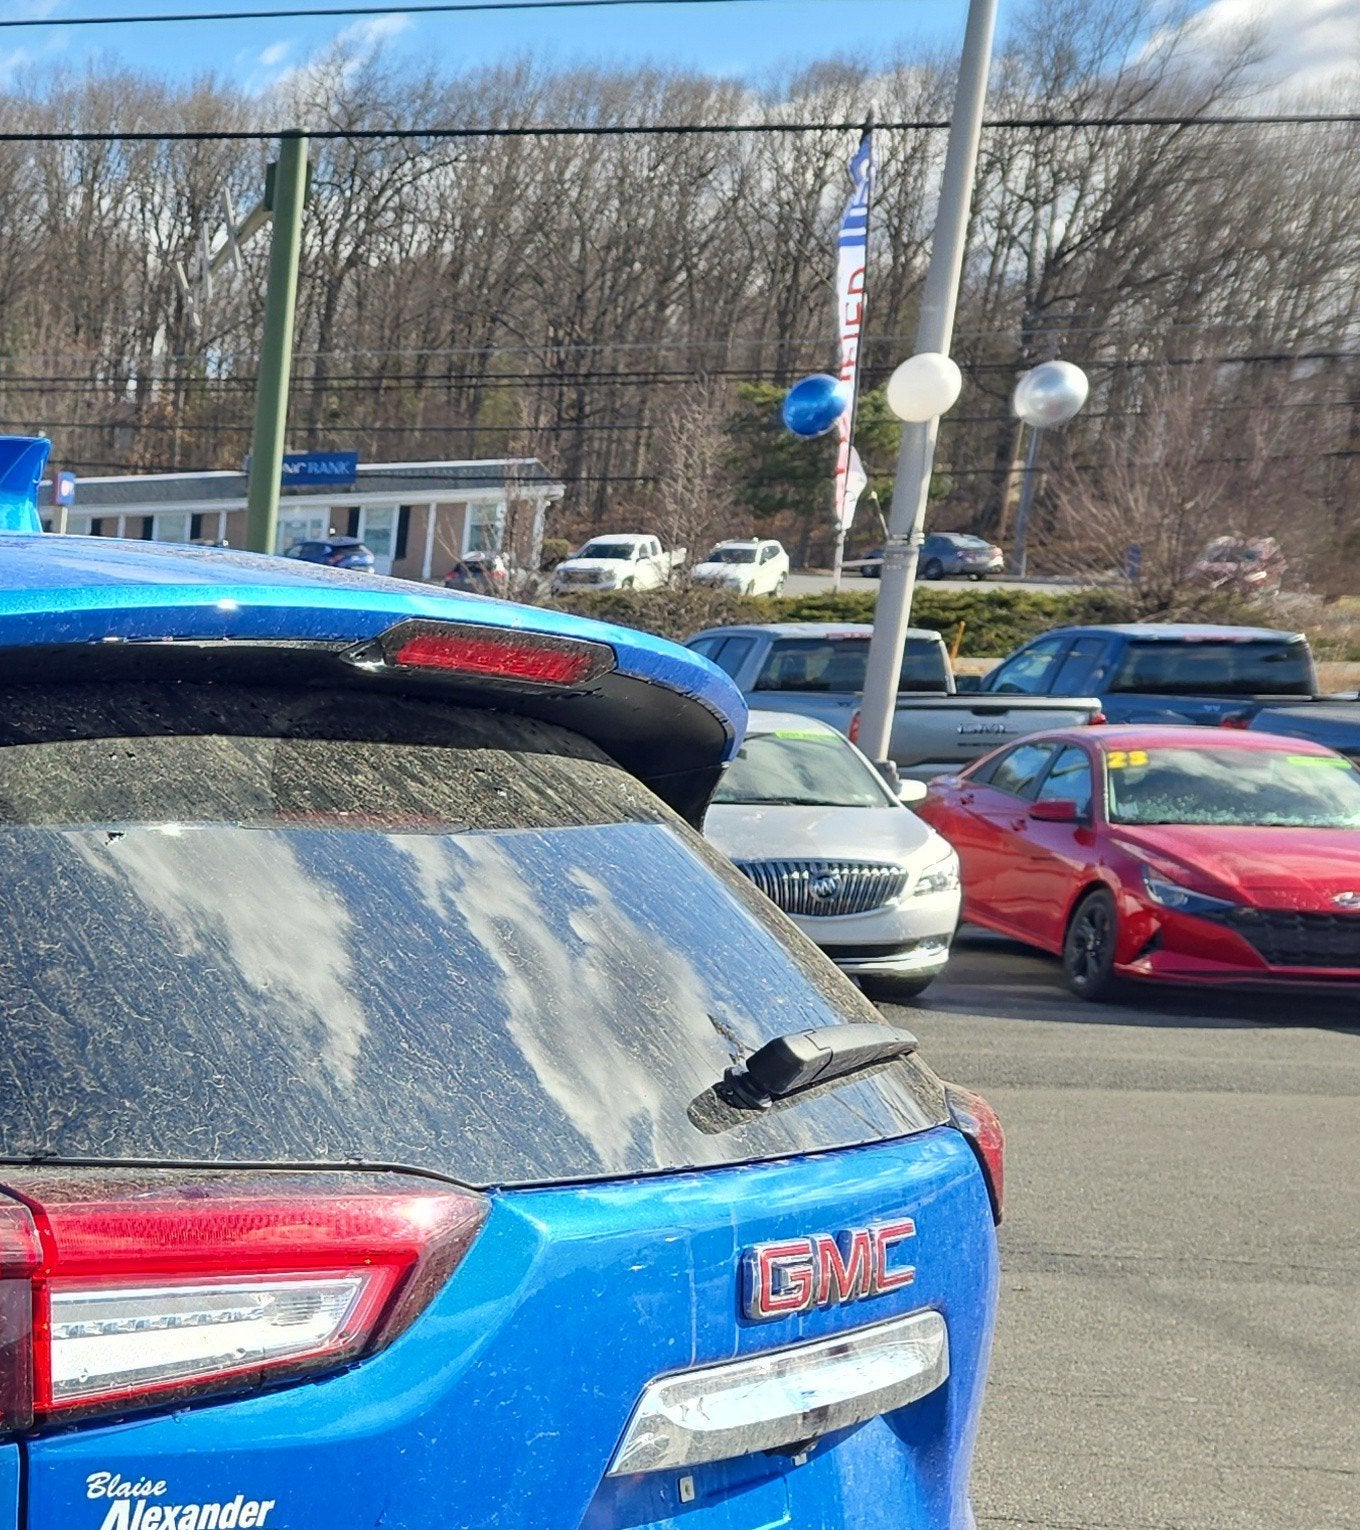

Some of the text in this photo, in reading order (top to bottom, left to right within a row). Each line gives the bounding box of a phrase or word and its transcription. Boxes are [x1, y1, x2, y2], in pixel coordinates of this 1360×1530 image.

[307, 461, 351, 475] BANK
[1108, 751, 1149, 769] 23
[743, 1217, 916, 1319] GMC
[86, 1471, 168, 1499] Blaise
